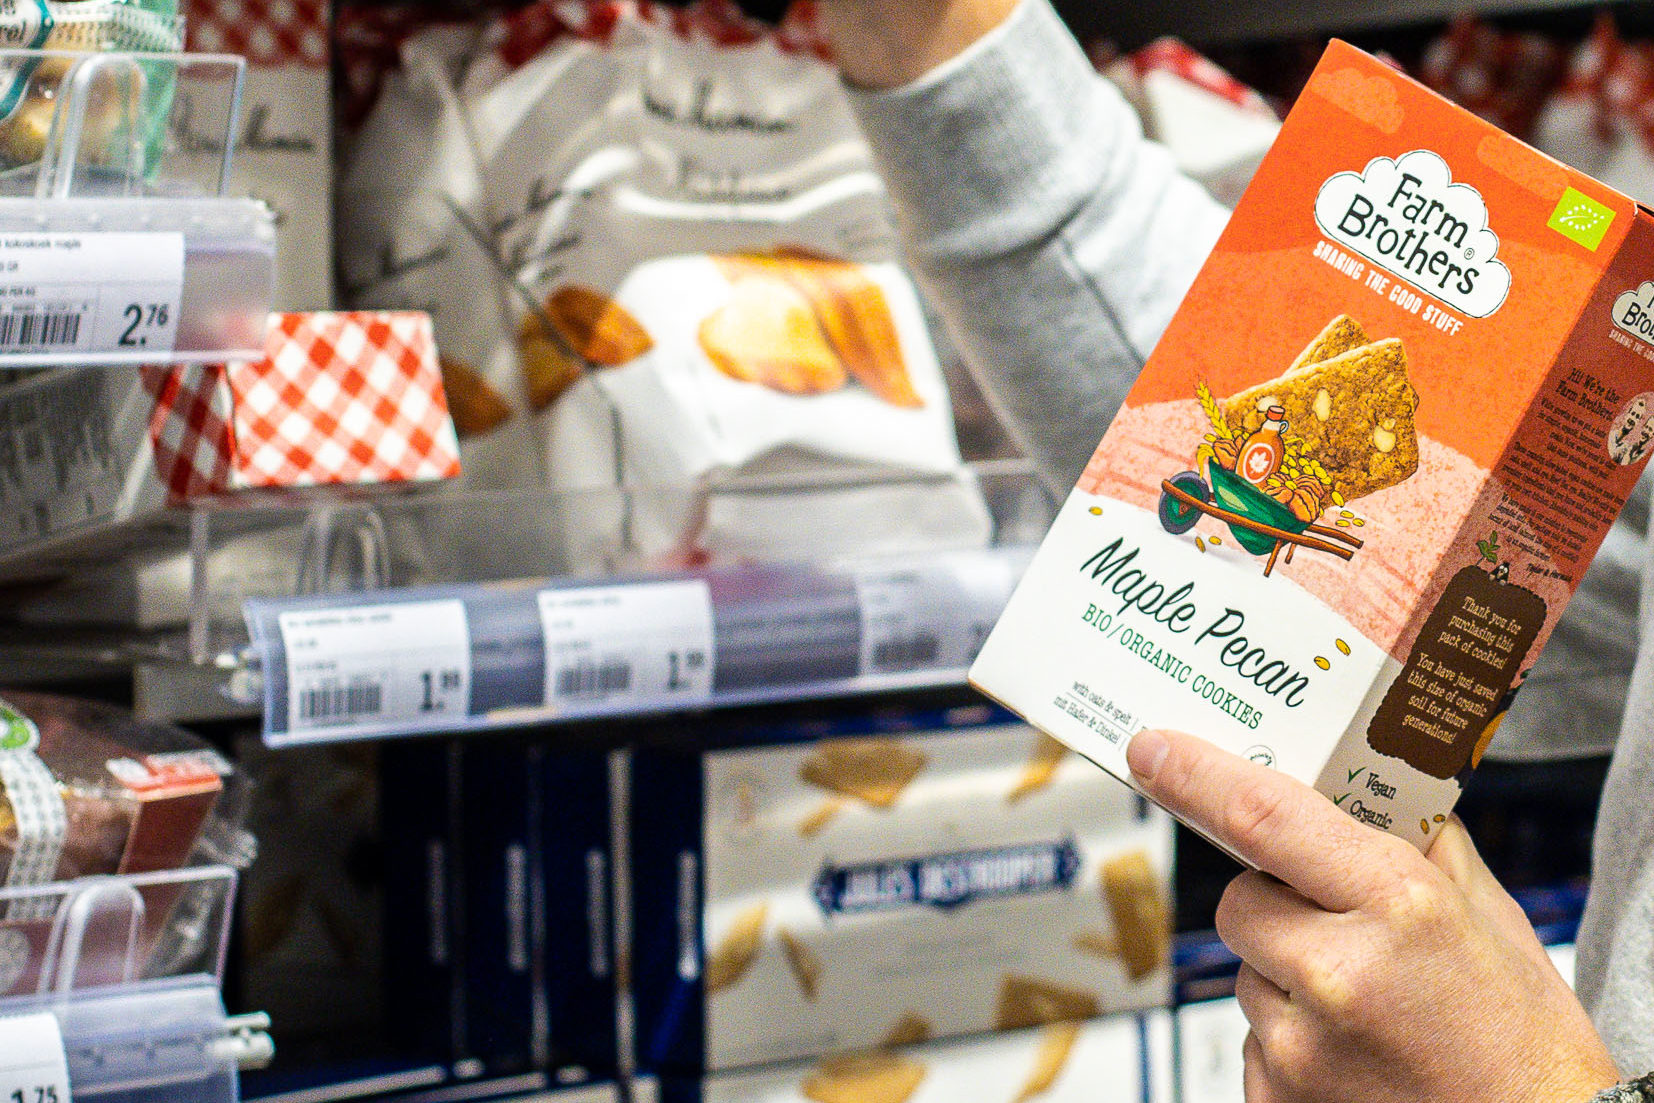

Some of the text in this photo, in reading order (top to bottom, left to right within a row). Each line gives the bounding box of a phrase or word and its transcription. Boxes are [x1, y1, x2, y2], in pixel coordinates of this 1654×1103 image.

[1387, 173, 1471, 249] Farm
[1337, 194, 1481, 296] Brothers
[1312, 240, 1465, 338] SHARING THE GOOD STUFF
[119, 301, 169, 347] 2.76
[1556, 380, 1578, 402] Farm
[1079, 536, 1310, 709] Maple Pecan
[1448, 615, 1514, 653] purchasing this
[1462, 596, 1522, 635] Thank you for
[1437, 631, 1508, 670] pack of cookies!
[1407, 670, 1488, 718] this size of organic
[1416, 652, 1499, 702] You have just saved
[1073, 682, 1089, 696] with
[1105, 701, 1114, 712] &
[1112, 708, 1132, 725] spelt
[1192, 673, 1265, 730] COOKIES
[1408, 695, 1468, 730] soil for future
[1066, 702, 1089, 723] Hafer
[1088, 717, 1096, 728] &
[1095, 721, 1119, 744] Dinkel
[1402, 714, 1457, 744] generations!
[1364, 772, 1397, 800] Vegan
[1350, 799, 1393, 831] Organic
